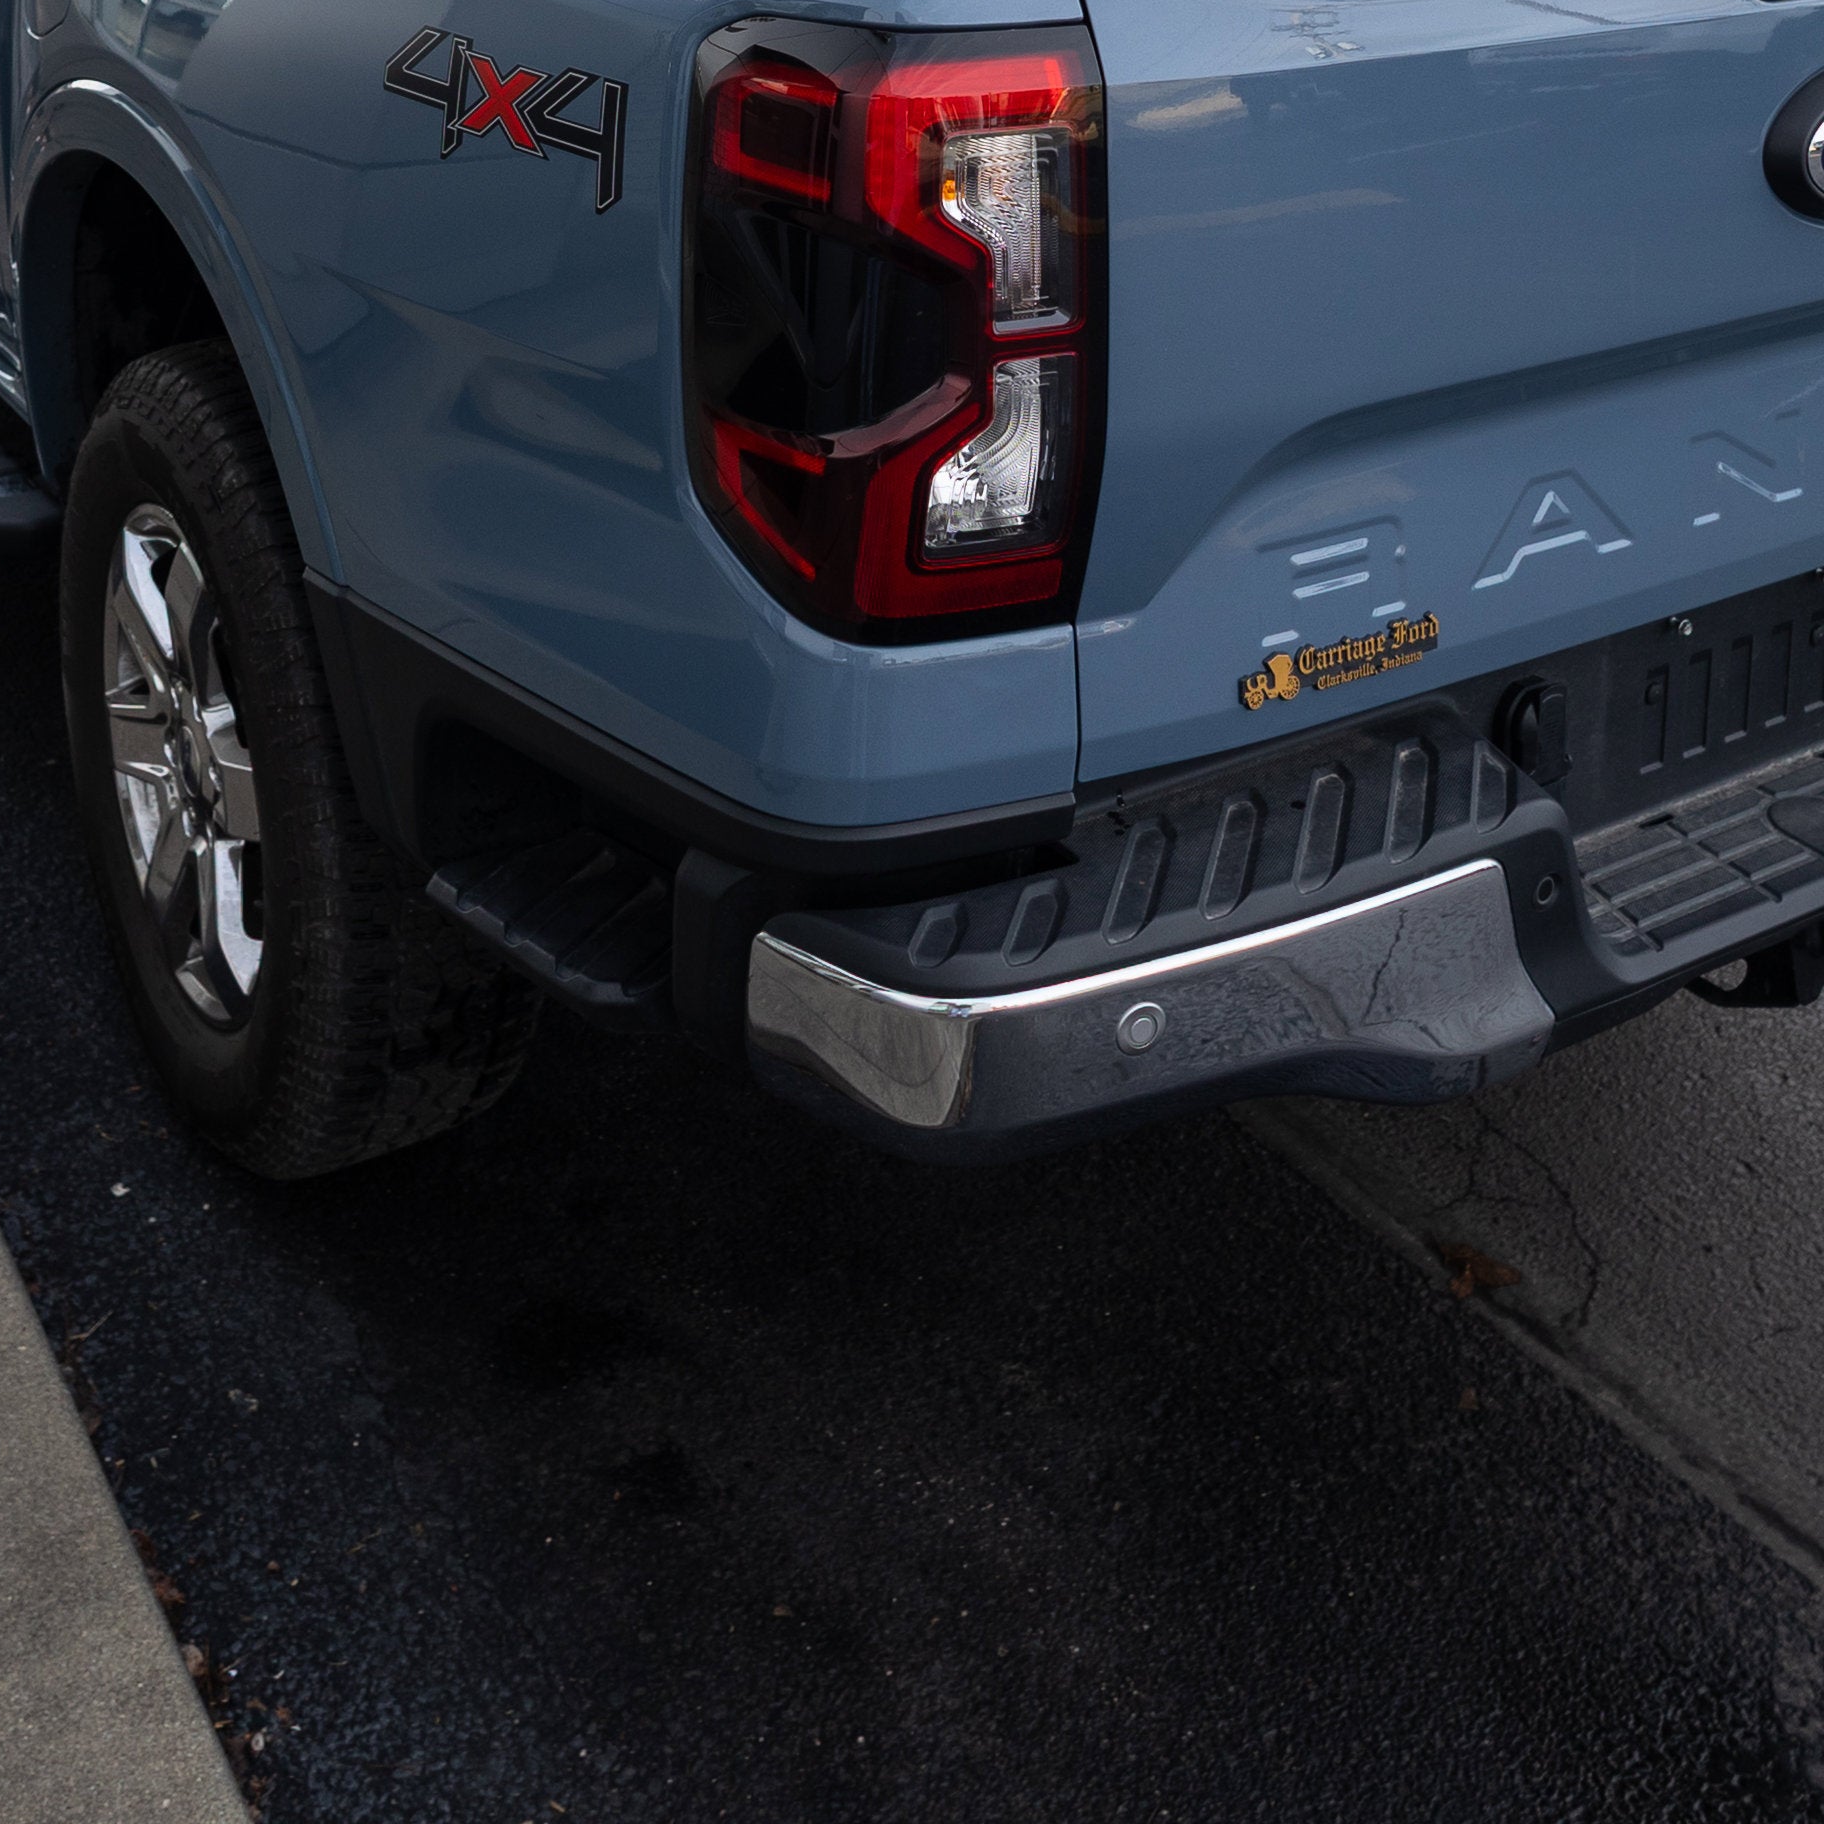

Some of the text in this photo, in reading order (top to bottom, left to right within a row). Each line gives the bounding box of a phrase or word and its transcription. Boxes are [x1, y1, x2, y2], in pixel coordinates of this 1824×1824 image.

[1298, 612, 1440, 674] Carriage Ford
[1316, 650, 1424, 690] Clarksville, Indiana
